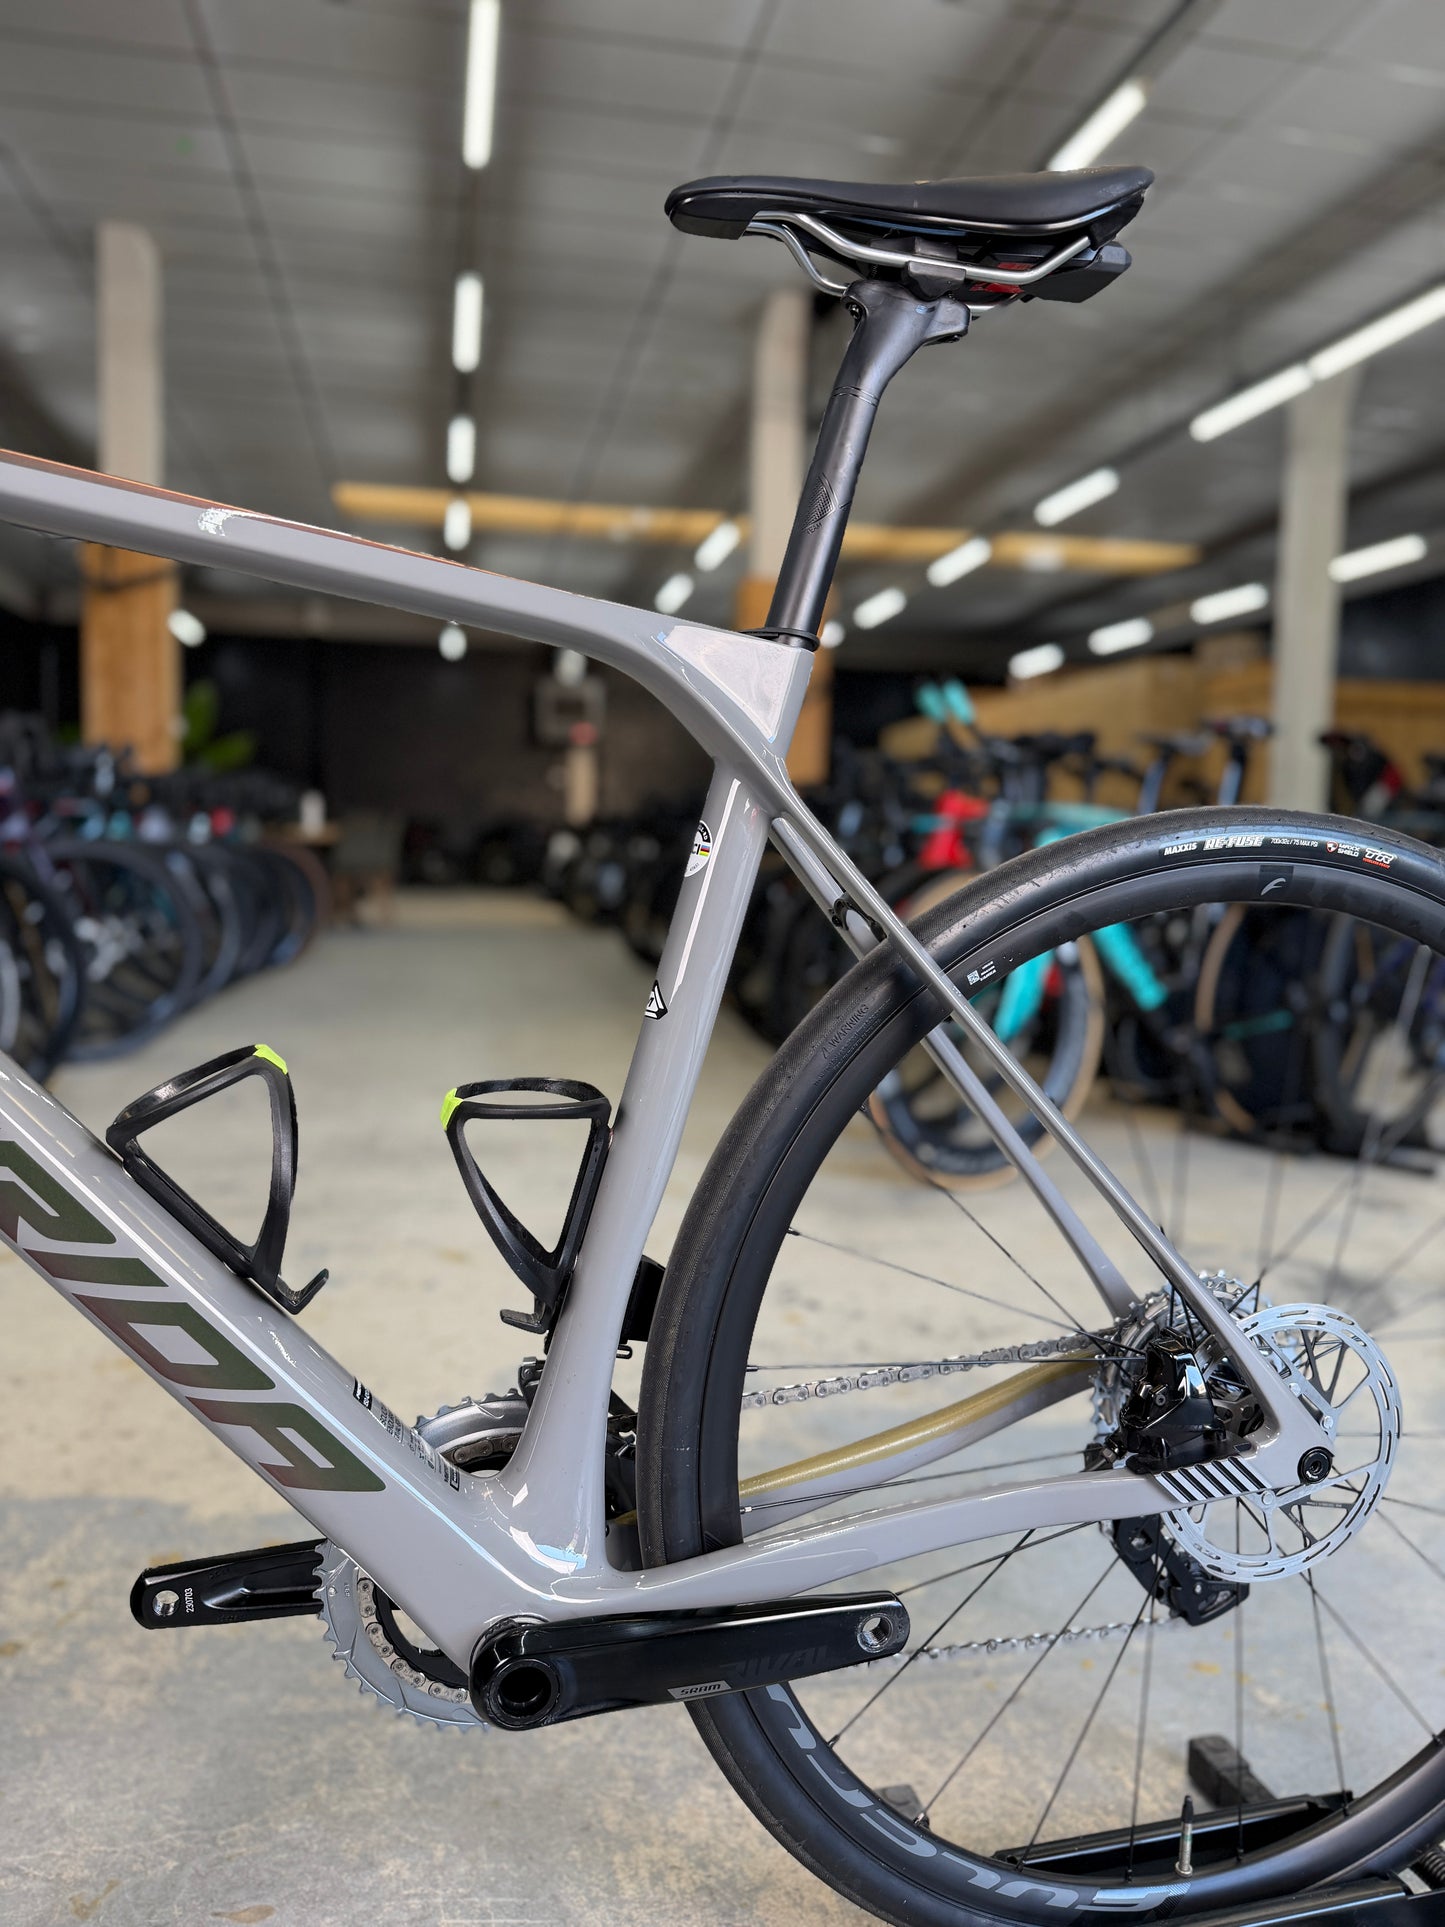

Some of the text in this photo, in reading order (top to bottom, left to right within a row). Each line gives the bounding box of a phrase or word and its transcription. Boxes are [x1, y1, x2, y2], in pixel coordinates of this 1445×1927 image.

[1163, 842, 1198, 856] MAXXIS
[828, 1003, 869, 1047] WARNING
[184, 1587, 194, 1613] 230703
[680, 1683, 721, 1696] SRAM
